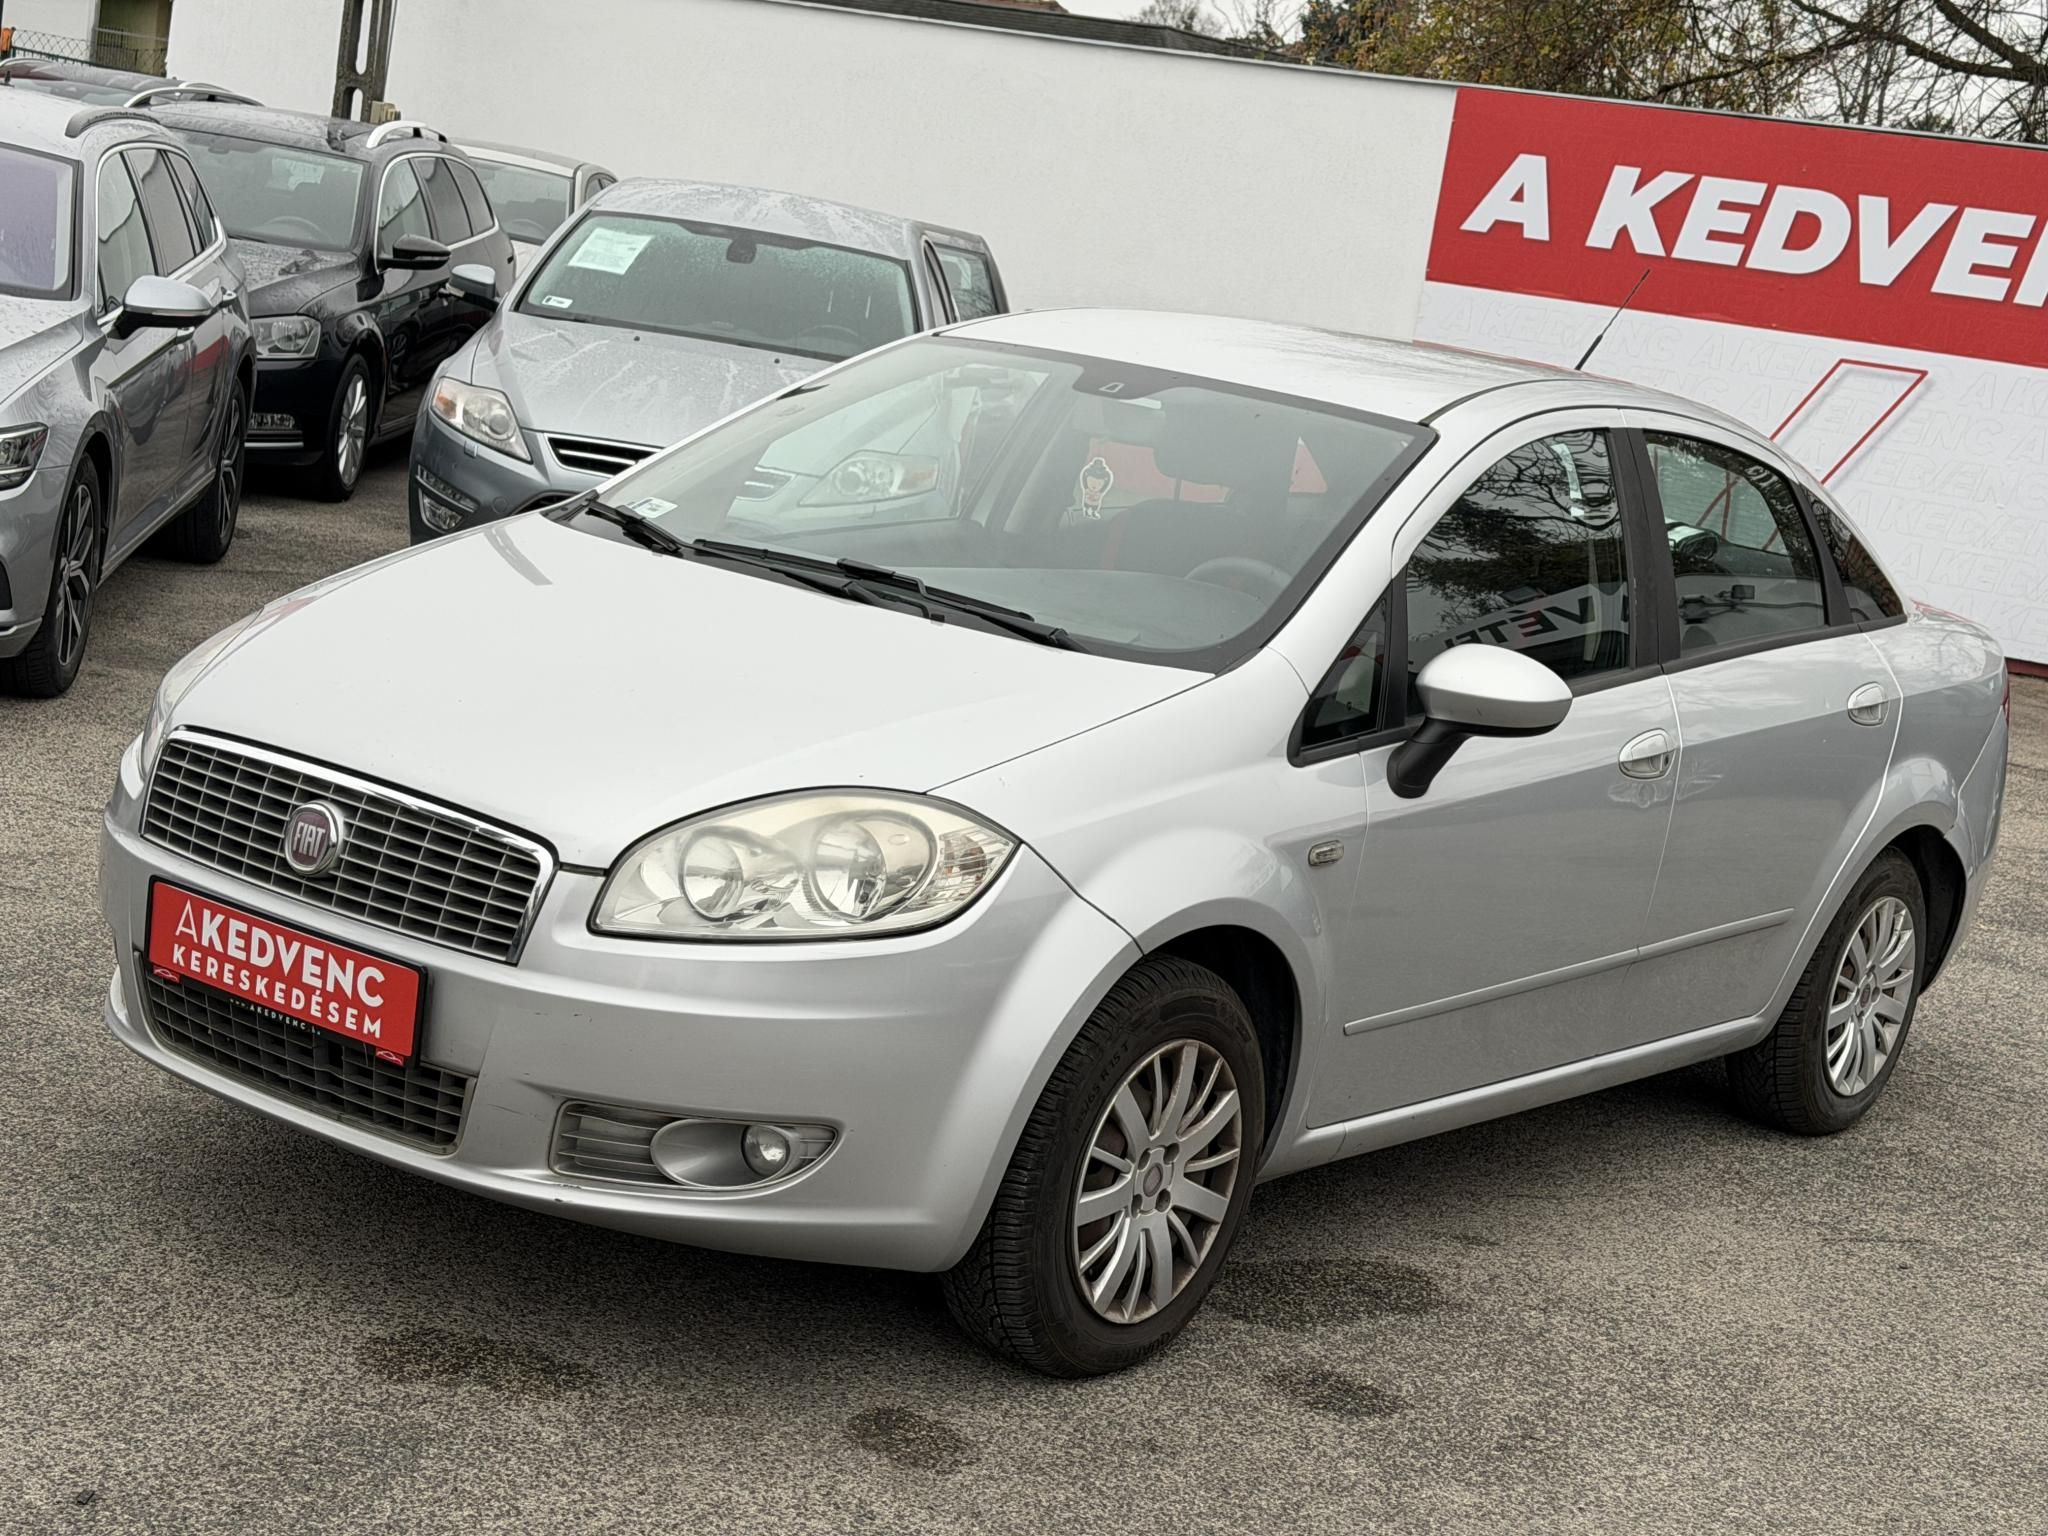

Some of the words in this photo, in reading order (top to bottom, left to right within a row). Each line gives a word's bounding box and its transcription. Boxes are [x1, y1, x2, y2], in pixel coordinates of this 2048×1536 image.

[1459, 153, 1550, 241] A
[293, 821, 326, 858] FIAT
[172, 943, 382, 1040] KERESKEDÉSEM
